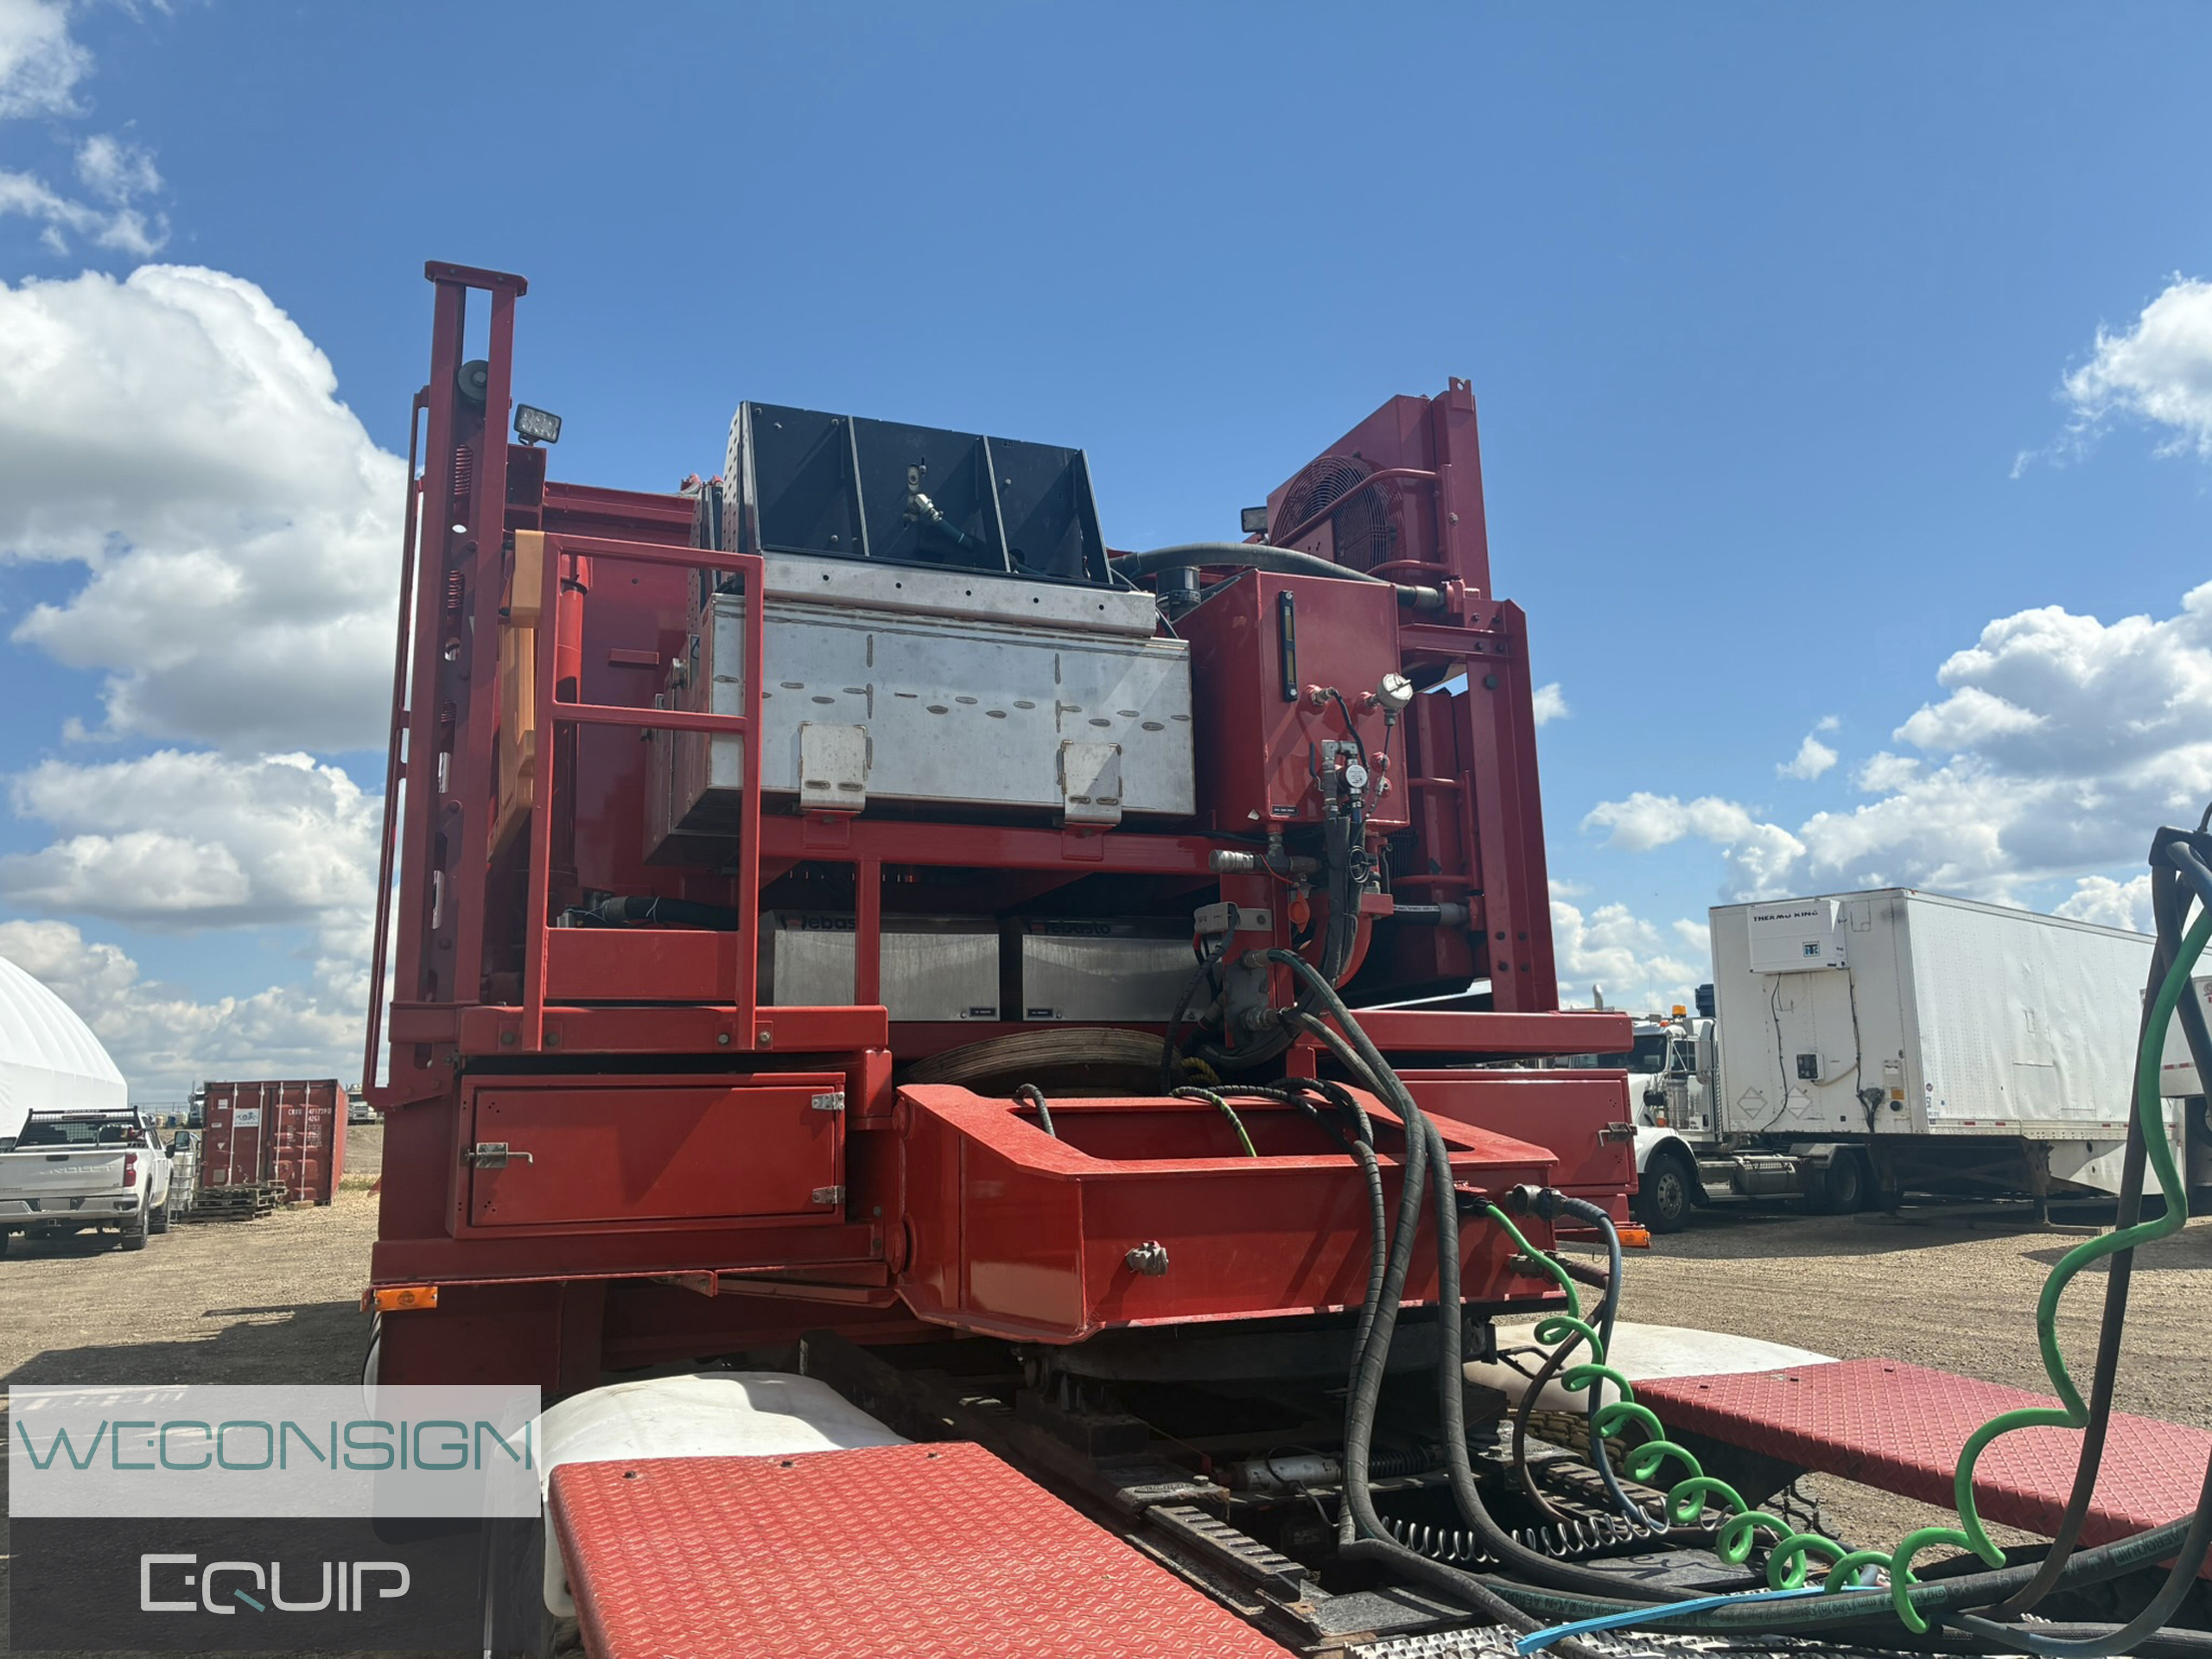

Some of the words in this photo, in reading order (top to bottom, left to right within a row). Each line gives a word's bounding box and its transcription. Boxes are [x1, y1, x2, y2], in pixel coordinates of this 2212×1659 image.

[779, 914, 855, 931] Webas
[1753, 913, 1792, 922] THERMO
[1794, 910, 1818, 918] KING
